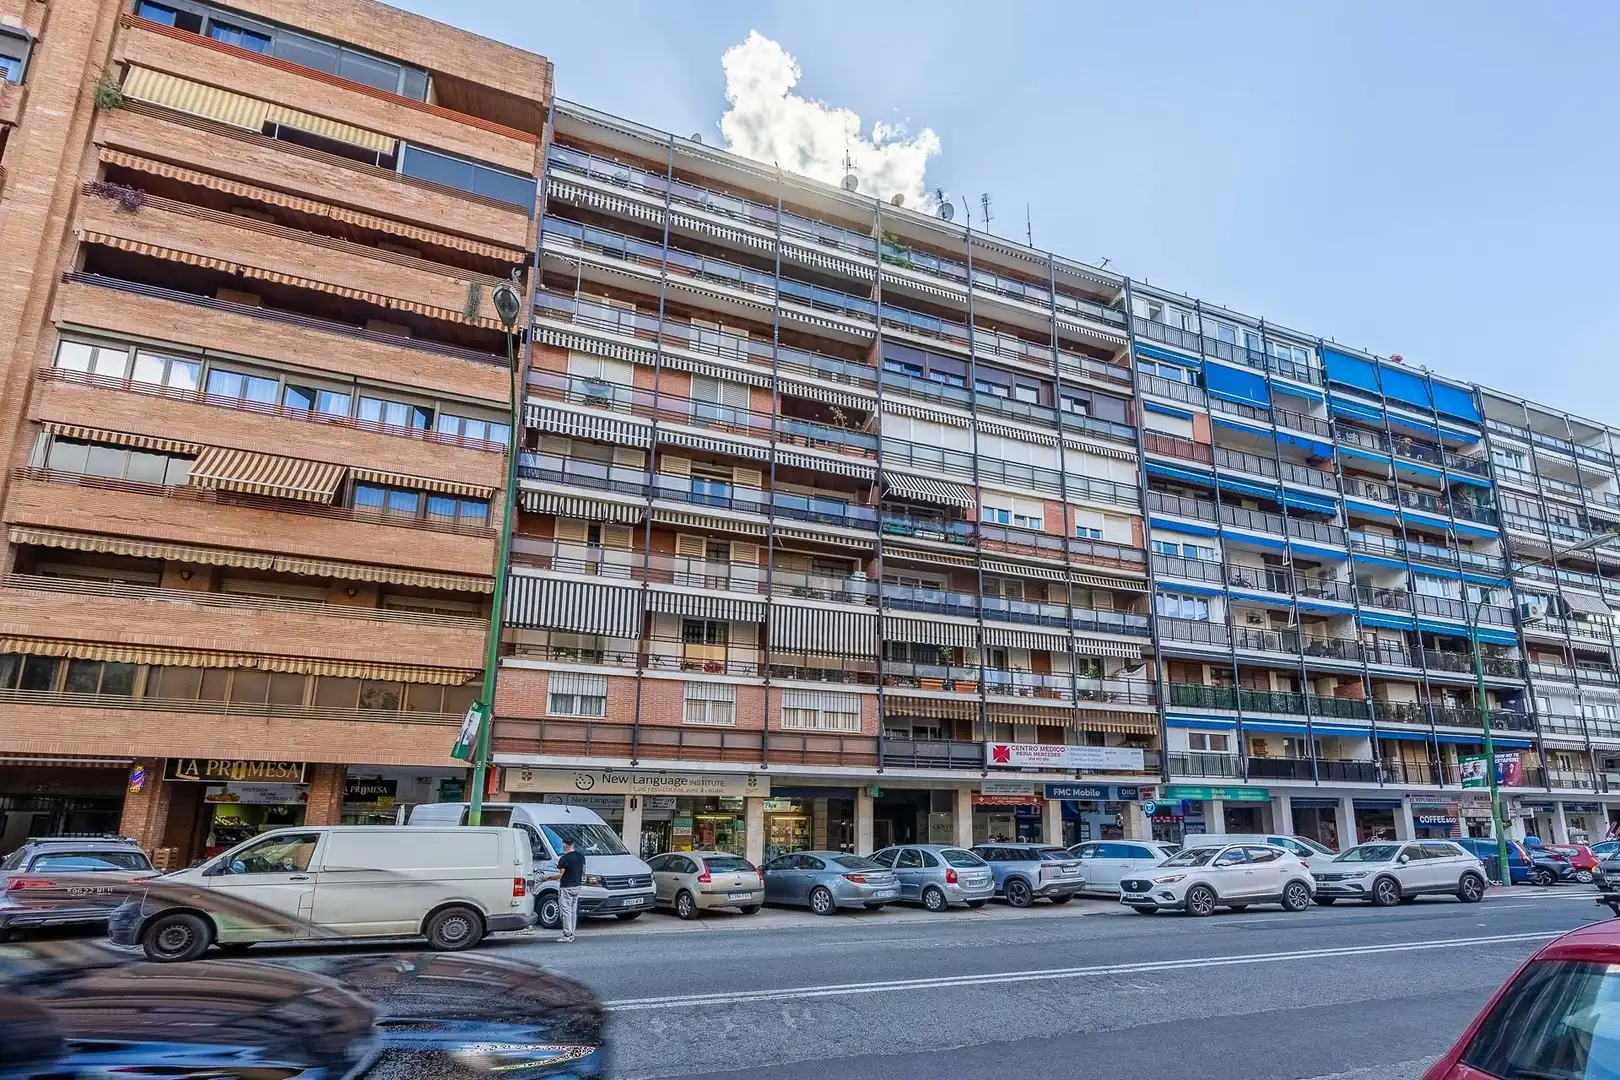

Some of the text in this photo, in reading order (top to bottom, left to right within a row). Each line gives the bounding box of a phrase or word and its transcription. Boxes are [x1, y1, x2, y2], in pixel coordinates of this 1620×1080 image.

[175, 759, 200, 780] LA
[602, 774, 725, 787] New Language INSTITUTE
[1053, 788, 1100, 797] FMC Mobile
[571, 796, 588, 804] New
[663, 798, 677, 806] 29
